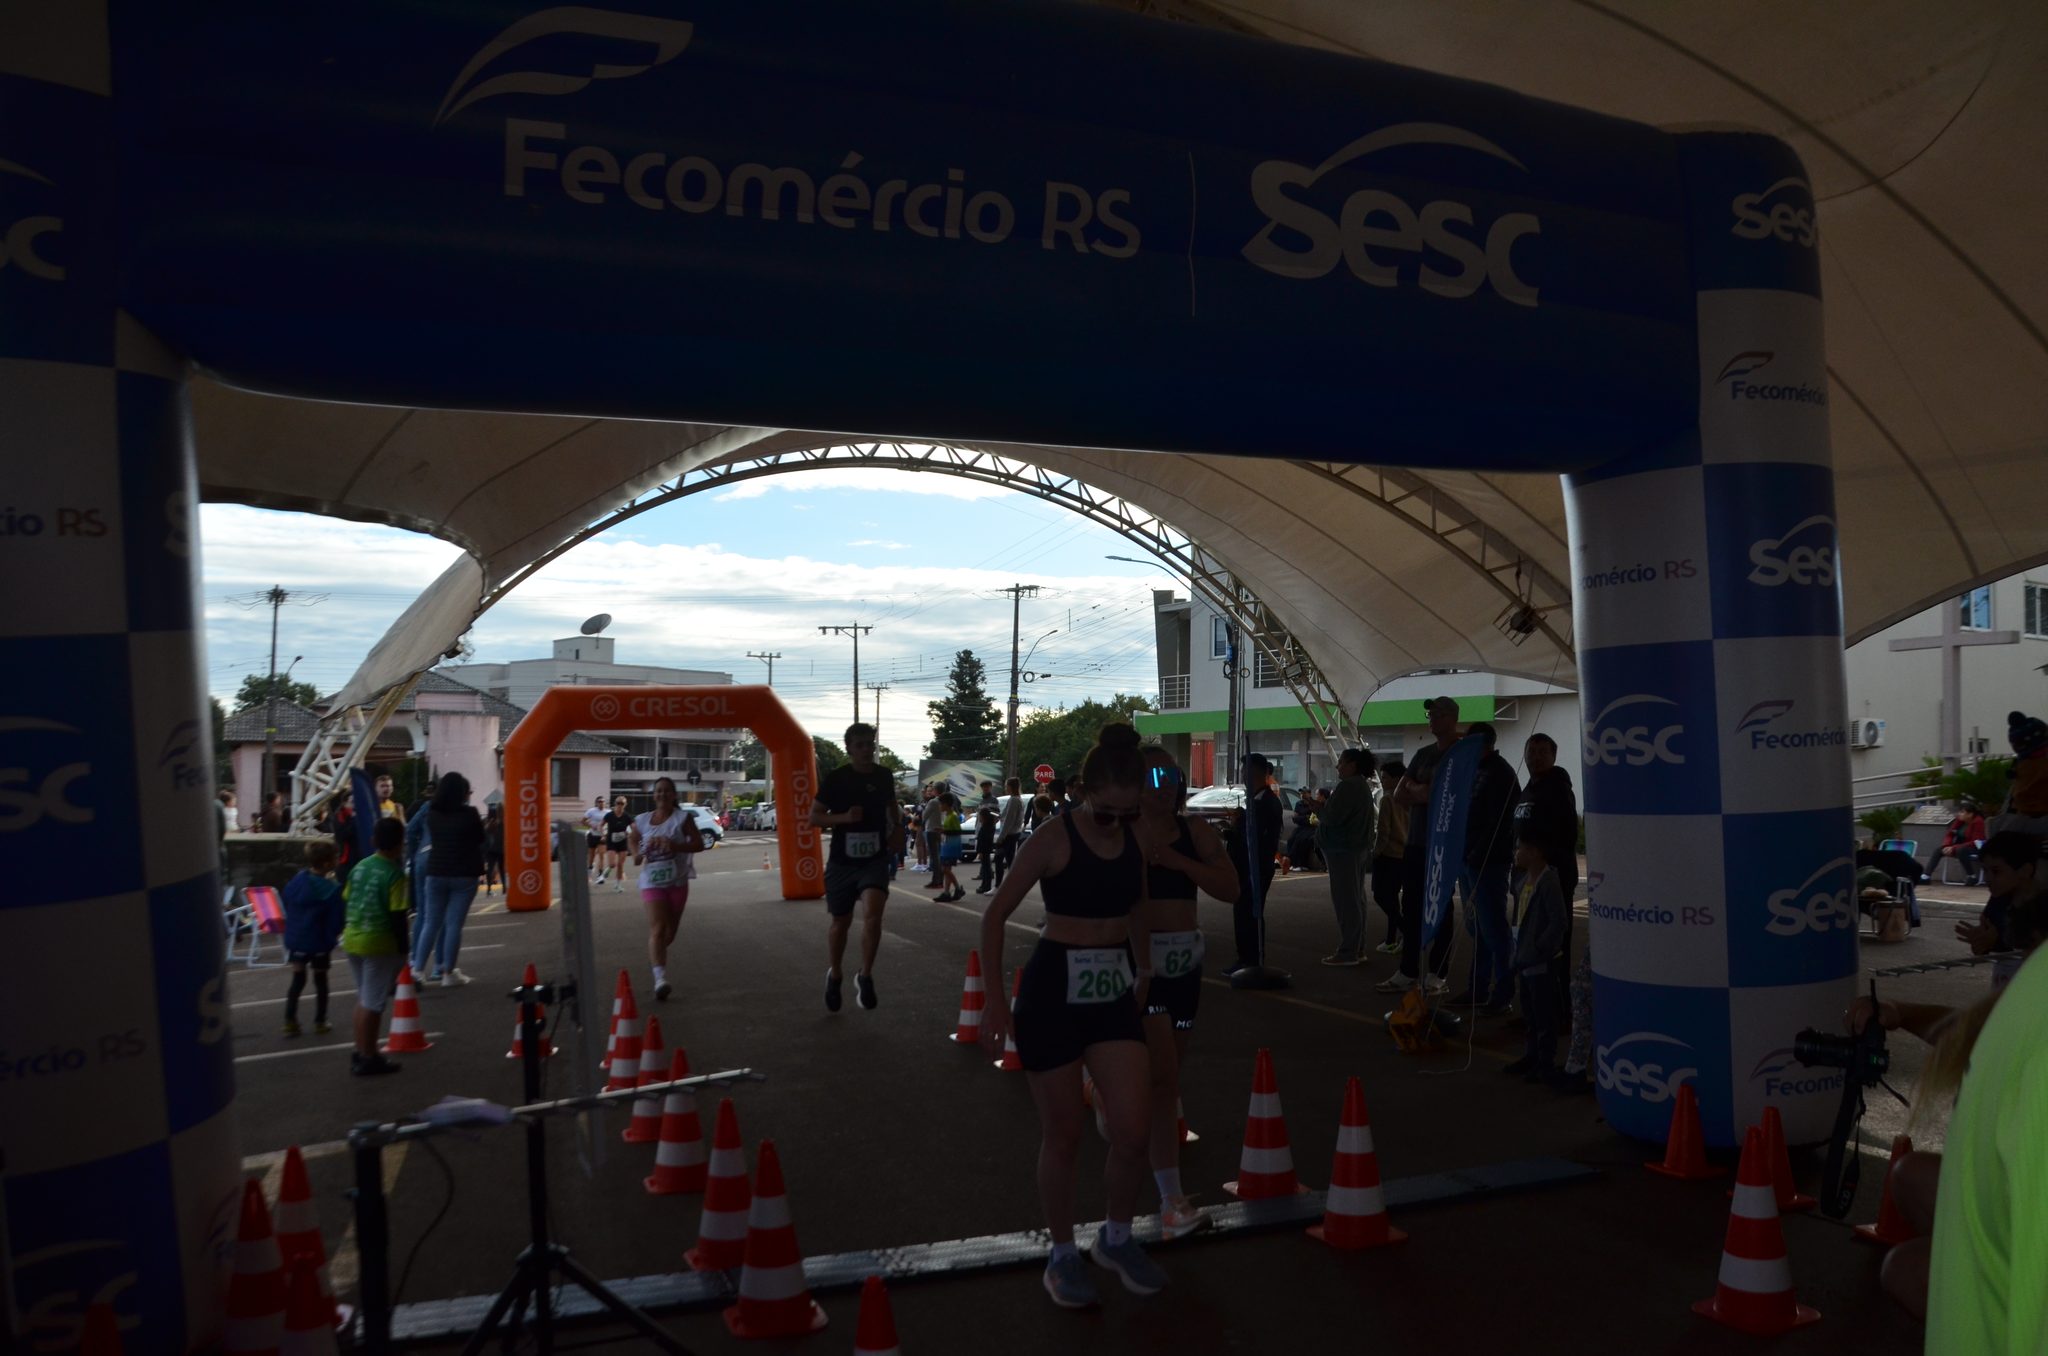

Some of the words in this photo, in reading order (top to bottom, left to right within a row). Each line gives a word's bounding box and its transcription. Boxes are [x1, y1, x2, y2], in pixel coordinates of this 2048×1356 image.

[503, 116, 1016, 244] Fecomércio
[1040, 180, 1142, 260] RS
[1240, 150, 1541, 308] Sesc
[56, 508, 107, 538] RS
[1664, 559, 1697, 581] RS
[629, 695, 736, 718] CRESOL
[1034, 770, 1054, 778] PARE
[518, 771, 538, 863] CRESOL
[792, 762, 814, 850] CRESOL
[1424, 845, 1445, 928] Sesc
[1681, 906, 1715, 926] RS
[1165, 949, 1193, 976] 62
[1077, 968, 1127, 999] 260
